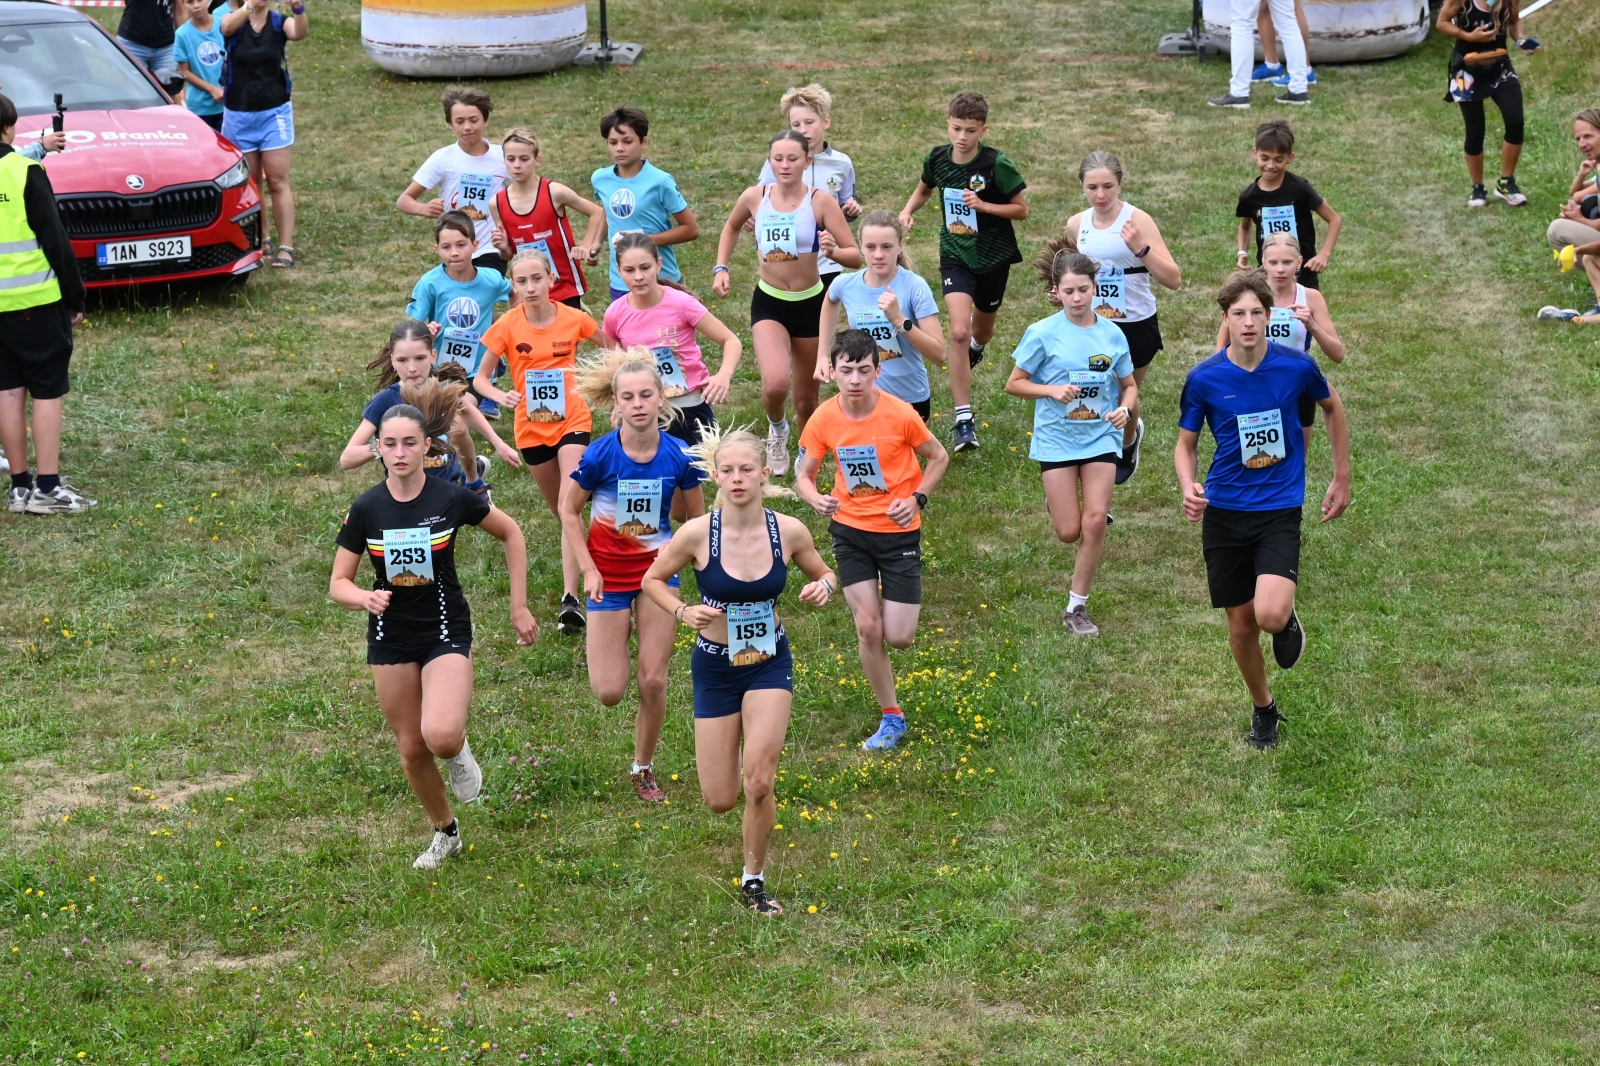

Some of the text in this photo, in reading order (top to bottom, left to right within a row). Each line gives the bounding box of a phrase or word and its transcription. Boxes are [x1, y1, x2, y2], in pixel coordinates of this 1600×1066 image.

[101, 129, 189, 141] Branka
[463, 186, 487, 201] 154
[949, 202, 971, 217] 159
[766, 227, 791, 242] 164
[1268, 220, 1292, 234] 158
[111, 239, 184, 262] 1AN S923
[1096, 284, 1119, 298] 152
[1265, 323, 1291, 338] 165
[446, 342, 473, 359] 162
[531, 385, 559, 401] 163
[1244, 428, 1280, 448] 250
[846, 462, 876, 477] 251
[626, 498, 652, 513] 161
[711, 509, 721, 557] IKE PRO
[767, 513, 779, 543] NIKE
[389, 547, 426, 566] 253
[735, 621, 767, 641] 153
